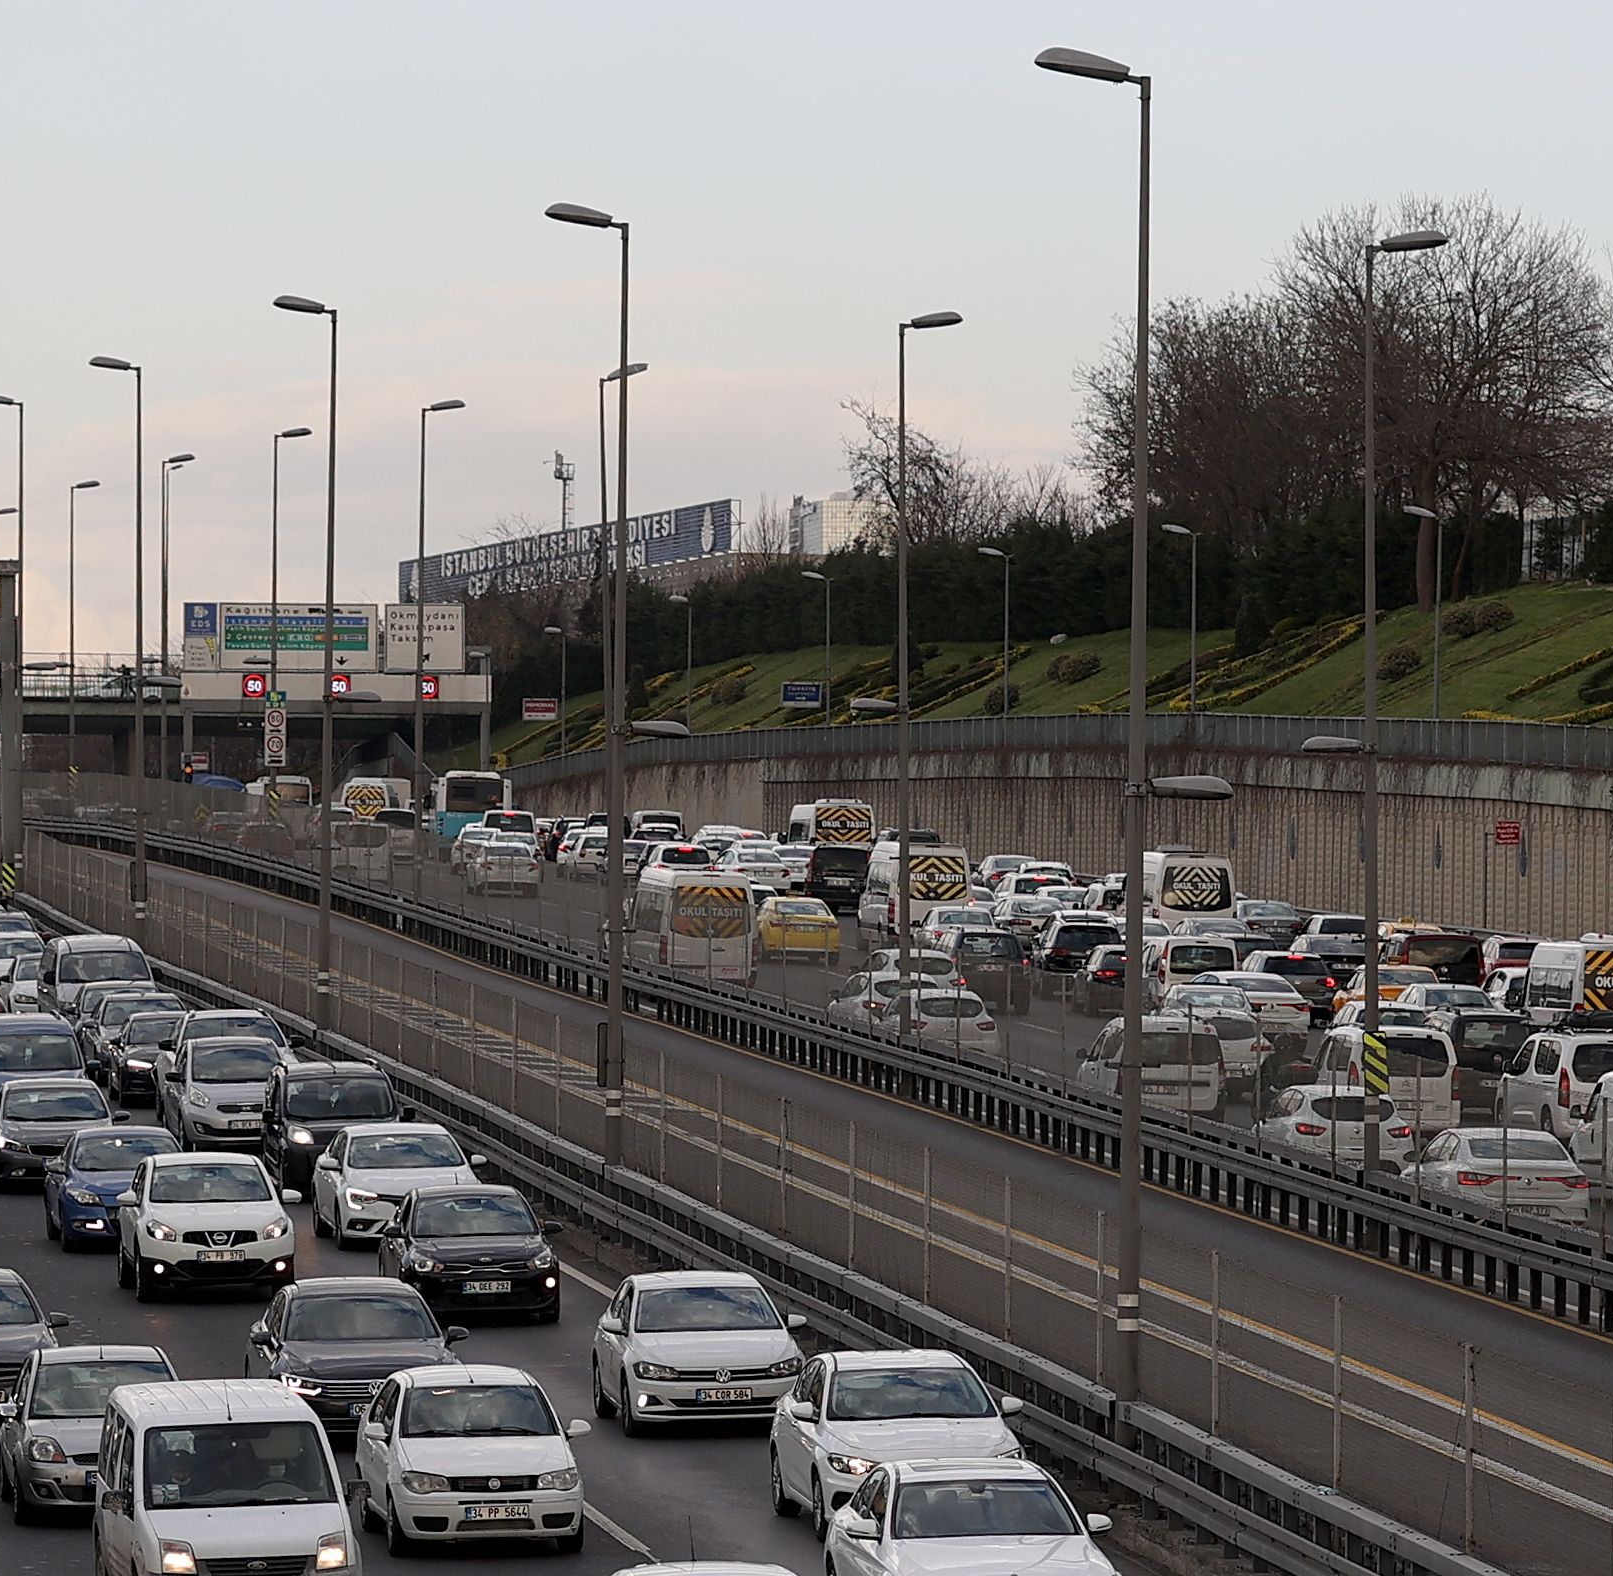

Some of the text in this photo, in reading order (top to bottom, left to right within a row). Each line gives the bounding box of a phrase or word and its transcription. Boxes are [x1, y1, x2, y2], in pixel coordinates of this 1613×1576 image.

[390, 611, 459, 621] Okmydanı
[390, 634, 434, 643] Taksm
[247, 681, 262, 692] 50
[331, 681, 346, 693] 50
[422, 682, 435, 693] 50
[270, 740, 281, 749] 70
[821, 820, 870, 829] OKUL TAŞITI
[909, 873, 964, 884] KUL TAŞITI
[1173, 882, 1194, 890] OKUL
[679, 906, 743, 919] OKUL TAŞITI
[467, 1282, 476, 1290] 34
[702, 1390, 712, 1400] 34
[734, 1389, 749, 1399] 584
[354, 1404, 366, 1414] 06
[472, 1507, 528, 1518] 34 PP 5644
